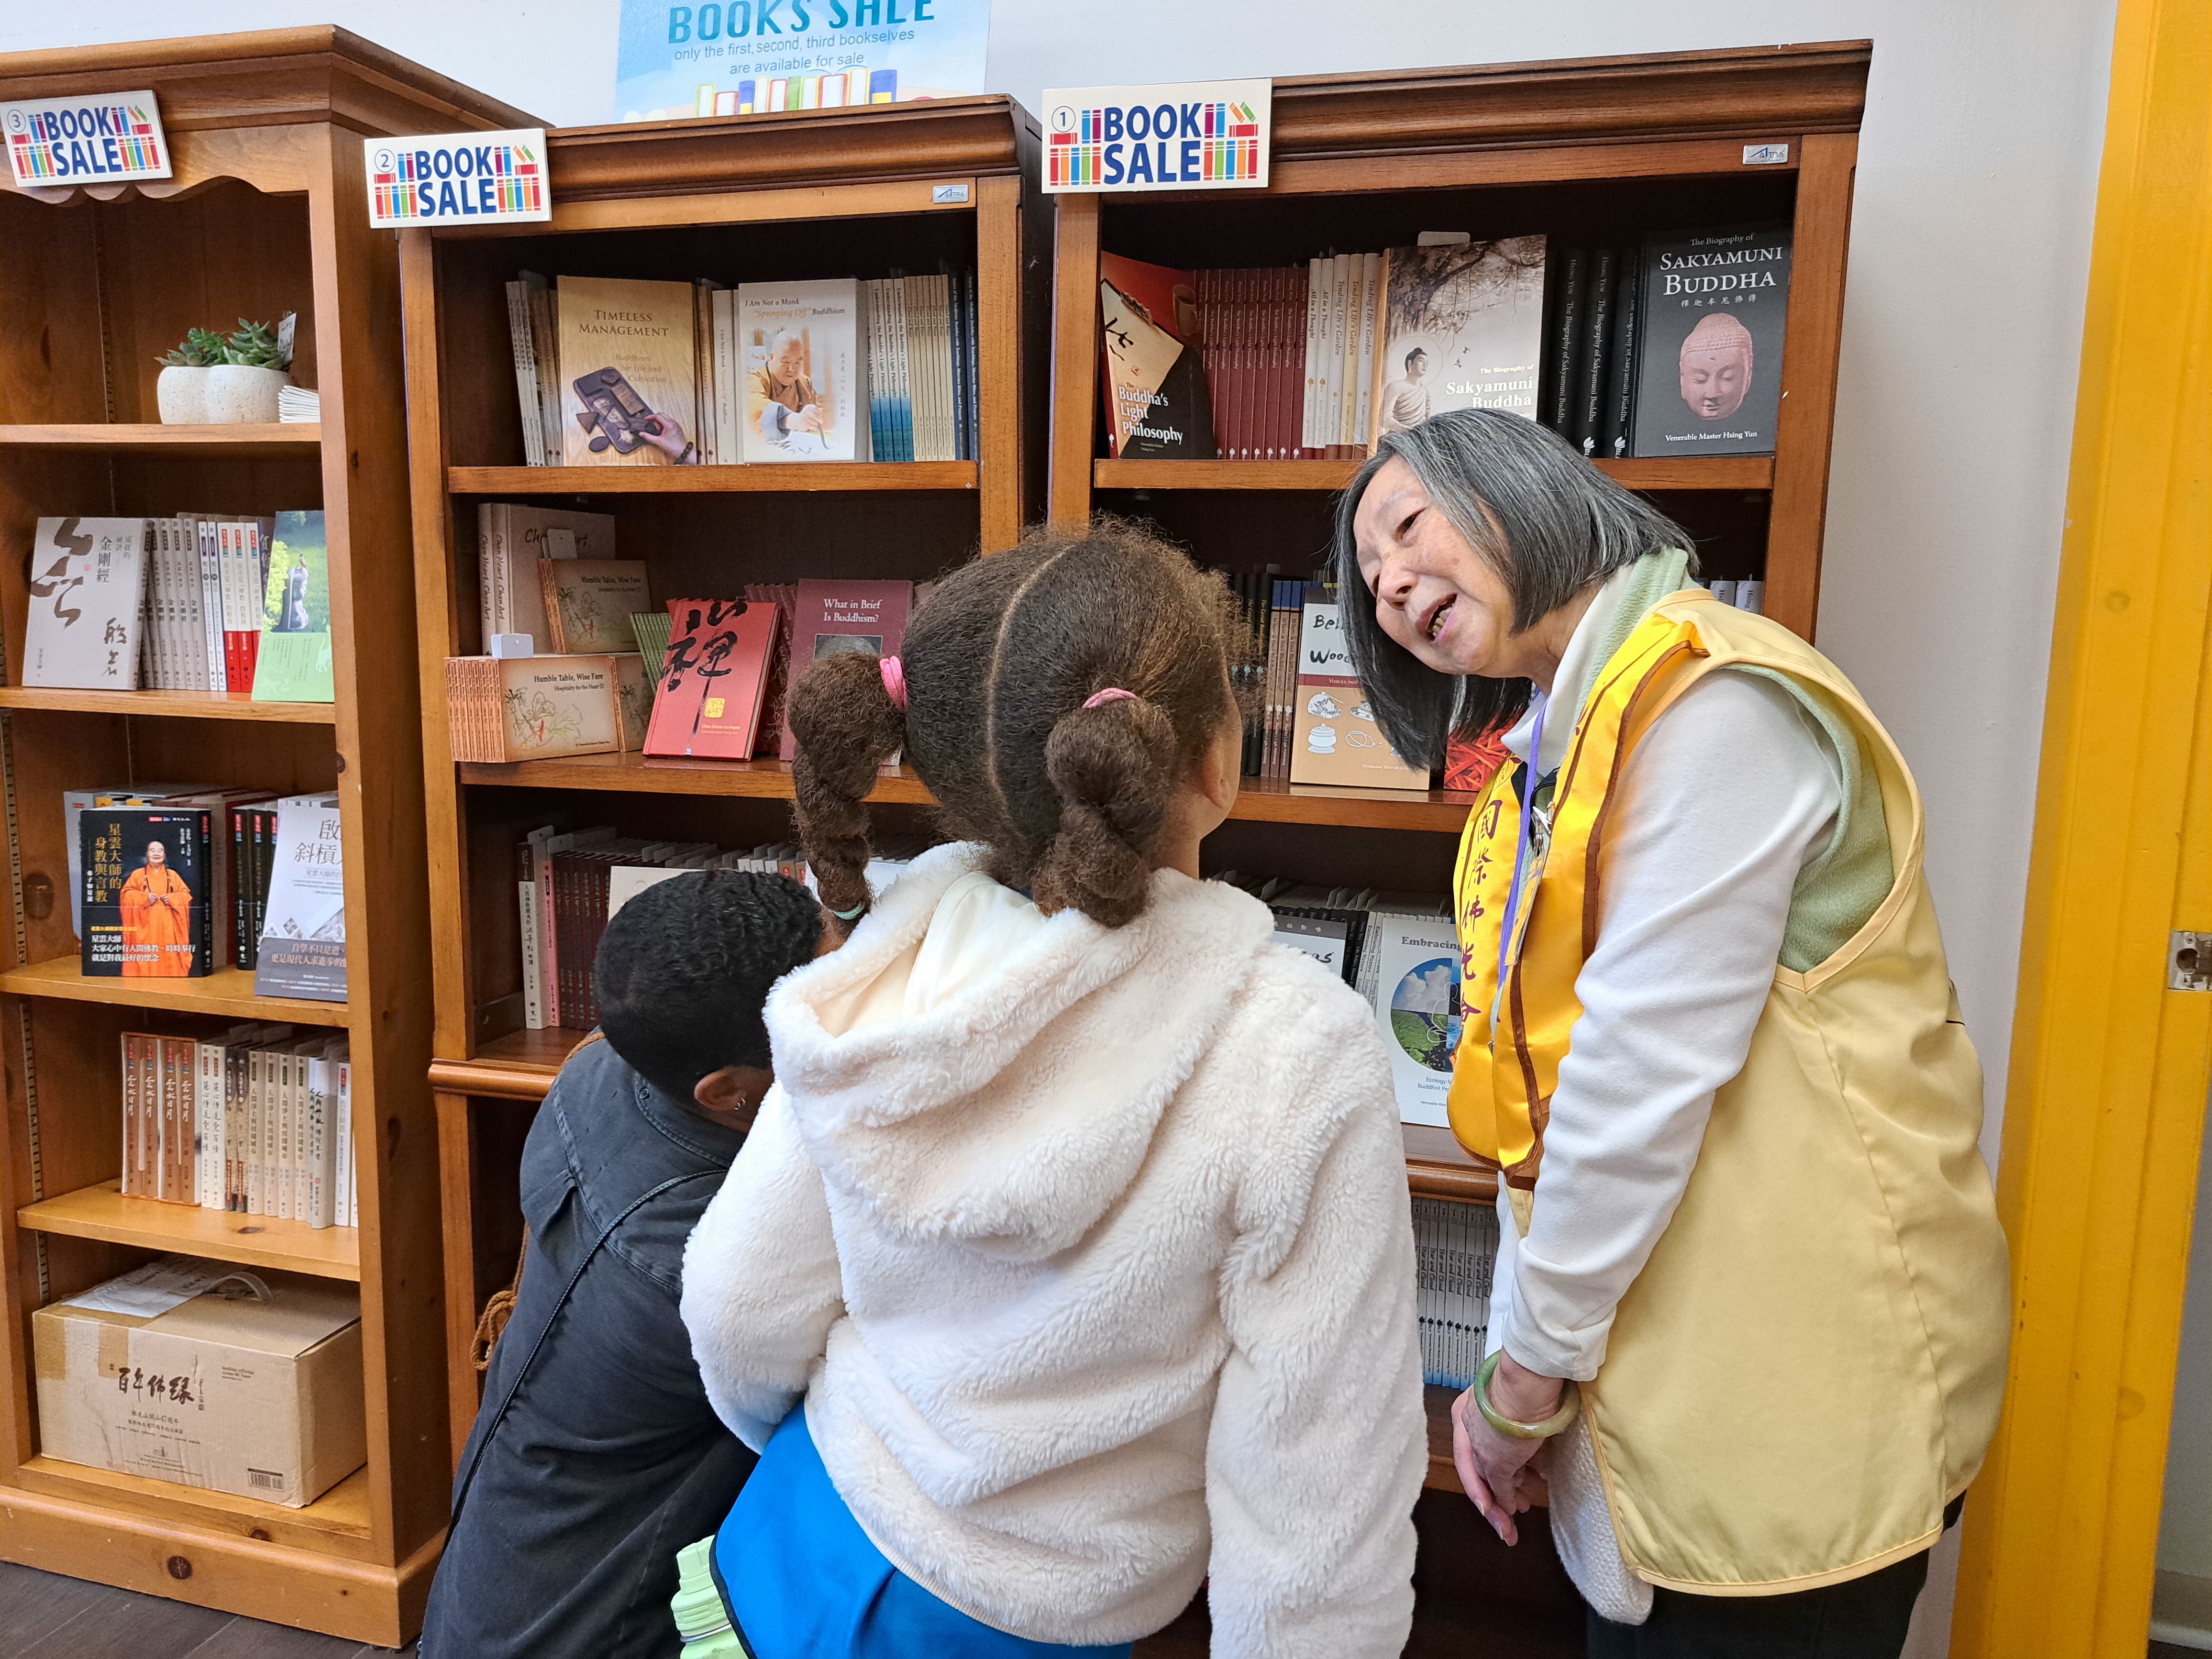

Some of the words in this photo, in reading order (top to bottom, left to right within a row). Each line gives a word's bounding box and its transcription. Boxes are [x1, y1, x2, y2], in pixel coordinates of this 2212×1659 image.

[668, 0, 810, 44] BOOKS
[829, 0, 935, 29] SALE
[675, 48, 700, 61] only
[705, 45, 724, 56] the
[728, 43, 754, 55] first,
[756, 37, 802, 54] second,
[807, 34, 835, 48] third
[839, 29, 915, 46] bookselves
[730, 64, 751, 75] are
[754, 57, 812, 72] available
[816, 54, 834, 67] for
[837, 52, 864, 65] sale
[43, 106, 115, 141] BOOK
[1104, 102, 1203, 142] BOOK
[52, 138, 123, 177] SALE
[415, 145, 495, 181] BOOK
[1103, 140, 1201, 185] SALE
[417, 178, 497, 217] SALE
[1706, 235, 1745, 245] Biography
[1746, 232, 1755, 241] of
[1660, 246, 1783, 270] SAKYAMUNI
[1335, 280, 1344, 308] Tending
[1349, 280, 1359, 308] Tending
[1663, 271, 1777, 295] BUDDHA
[593, 310, 653, 322] TIMELESS
[1566, 301, 1574, 314] The
[1597, 299, 1605, 312] The
[579, 323, 669, 336] MANAGEMENT
[1561, 316, 1573, 350] Biography
[1593, 314, 1604, 349] Biography
[1562, 351, 1570, 359] of
[1594, 350, 1602, 358] of
[1493, 365, 1525, 374] Biography
[1559, 360, 1569, 396] Sakyamuni
[1591, 358, 1601, 395] Sakyamuni
[1118, 387, 1169, 407] Buddha's
[1446, 376, 1533, 396] Sakyamuni
[1120, 402, 1149, 421] Light
[1472, 394, 1532, 408] Buddha
[1558, 398, 1566, 424] Buddha
[1588, 396, 1597, 422] Buddha
[1122, 421, 1183, 445] Philosophy
[1665, 433, 1697, 442] Venerable
[1723, 431, 1743, 440] Hsing
[97, 536, 112, 583] 金剛經
[824, 598, 848, 608] What
[850, 599, 858, 608] in
[861, 599, 883, 609] Brief
[823, 612, 831, 621] Is
[834, 612, 879, 623] Buddhism?
[318, 819, 342, 841] 啟
[109, 823, 122, 889] 星雲大師的
[294, 842, 343, 865] 斜槓
[95, 836, 108, 903] 身教與言教
[1401, 936, 1461, 952] Embracing
[1426, 1077, 1447, 1085] Ecology
